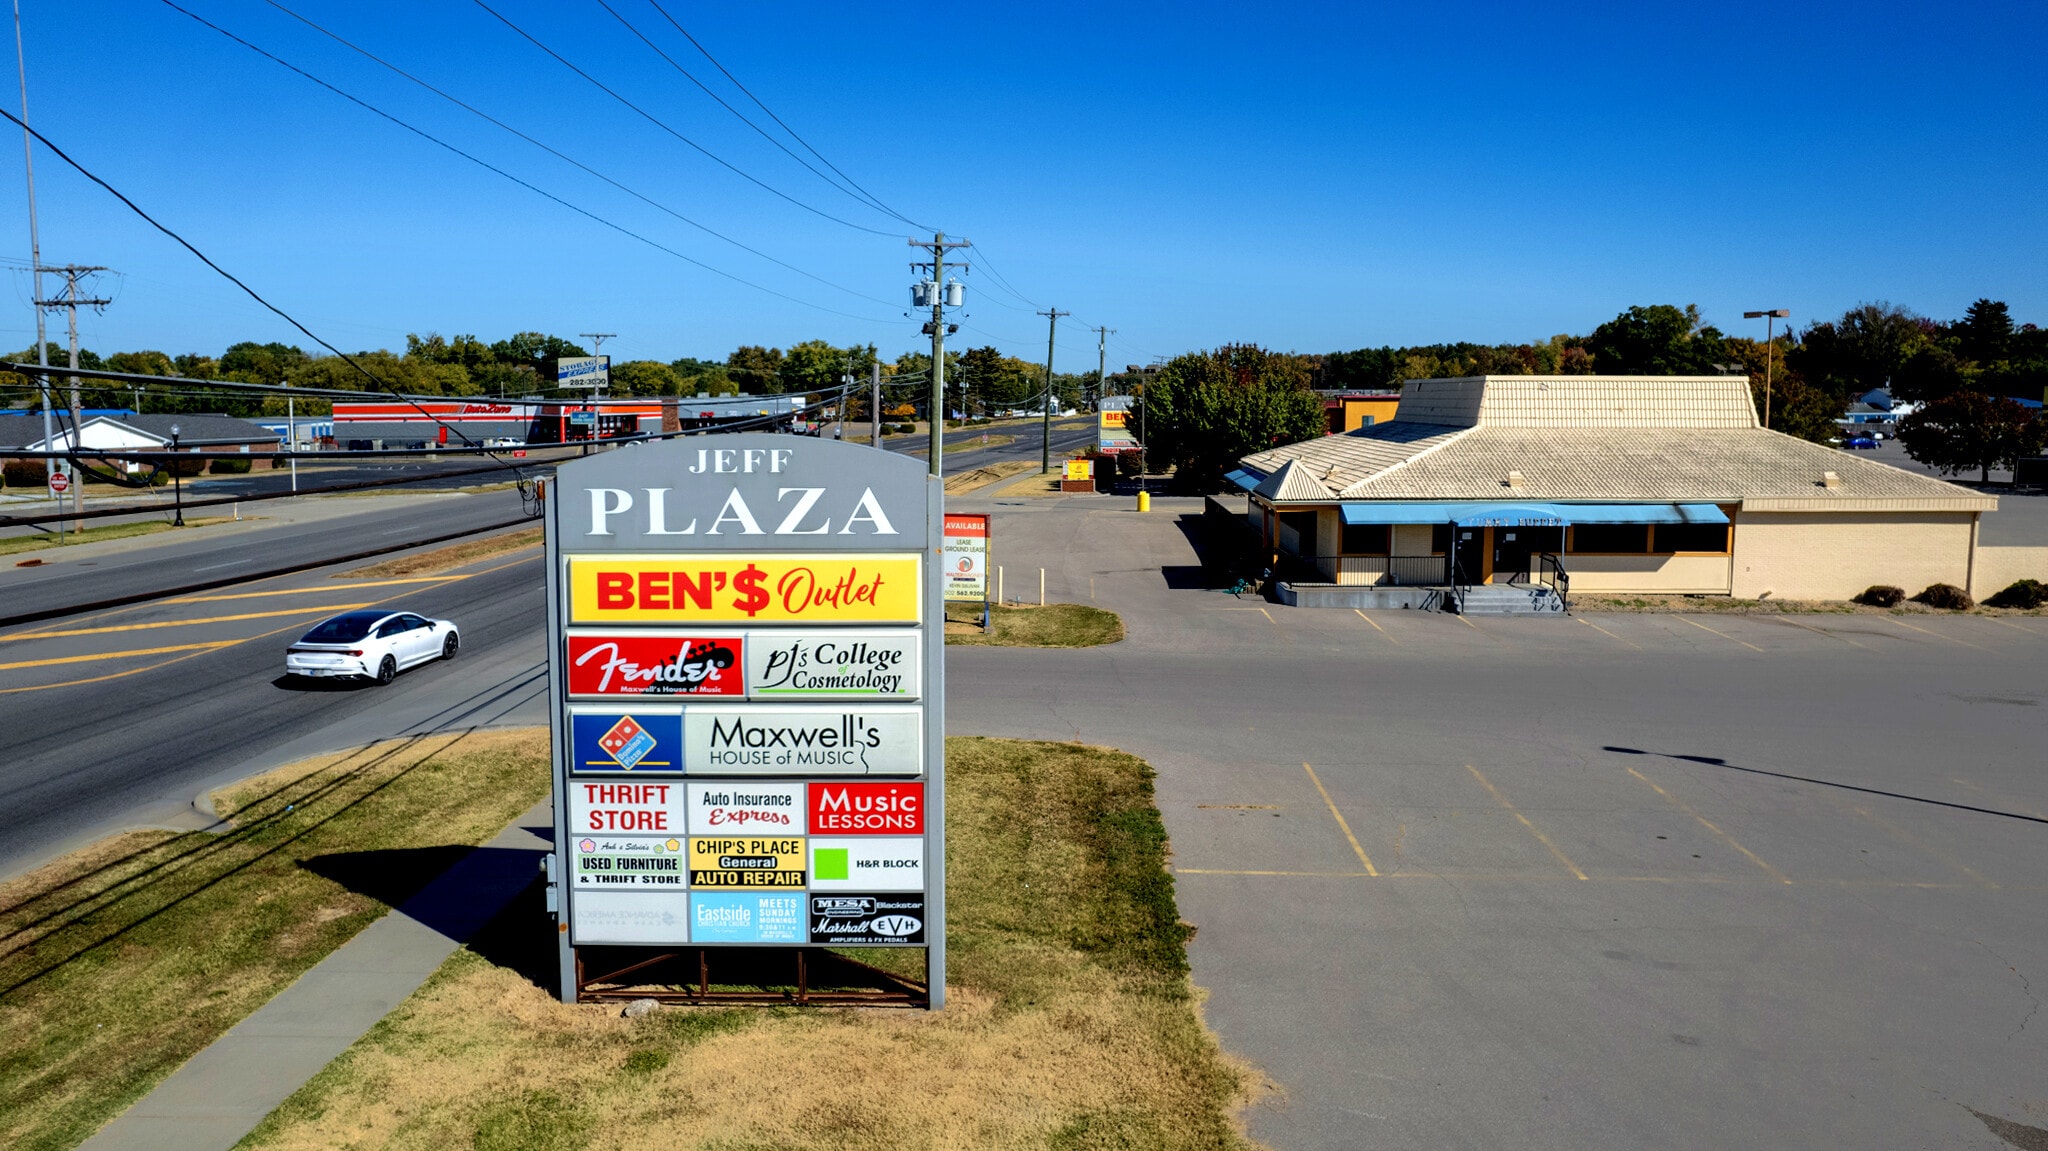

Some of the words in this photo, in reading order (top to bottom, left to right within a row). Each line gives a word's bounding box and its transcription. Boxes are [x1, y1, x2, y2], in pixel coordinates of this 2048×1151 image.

[560, 360, 598, 371] STORAG
[568, 364, 607, 377] EXPRES
[463, 404, 512, 413] AutoZone
[689, 449, 794, 474] JEFF
[584, 486, 900, 536] PLAZA
[945, 522, 985, 530] AVAILABLE
[777, 567, 885, 614] Outlet
[815, 643, 902, 671] College
[838, 665, 849, 675] of
[792, 669, 902, 693] Cosmetology
[620, 685, 661, 693] Maxwell's
[663, 685, 687, 693] House
[689, 685, 698, 693] of
[699, 685, 722, 693] Music
[710, 714, 881, 748] Maxwell's
[710, 751, 771, 765] HOUSE
[776, 750, 791, 765] of
[797, 751, 855, 765] MUSIC
[584, 784, 670, 804] THRIFT
[703, 791, 730, 806] Auto
[733, 791, 792, 806] Insurance
[589, 810, 668, 830] STORE
[708, 808, 790, 826] Express
[819, 814, 916, 829] LESSONS
[696, 840, 746, 854] CHIP'S
[751, 840, 799, 854] PLACE
[582, 857, 612, 870] USED
[616, 857, 678, 871] FURNITURE
[720, 857, 776, 868] General
[856, 860, 880, 868] H&R
[883, 860, 919, 868] BLOCK
[594, 875, 637, 884] THRIFT
[642, 875, 681, 884] STORE
[695, 871, 739, 885] AUTO
[743, 871, 802, 885] REPAIR
[759, 898, 797, 908] MEETS
[816, 900, 871, 908] MESA
[697, 904, 751, 921] Eastside
[759, 909, 796, 917] SUNDAY
[811, 918, 871, 934] Marshall
